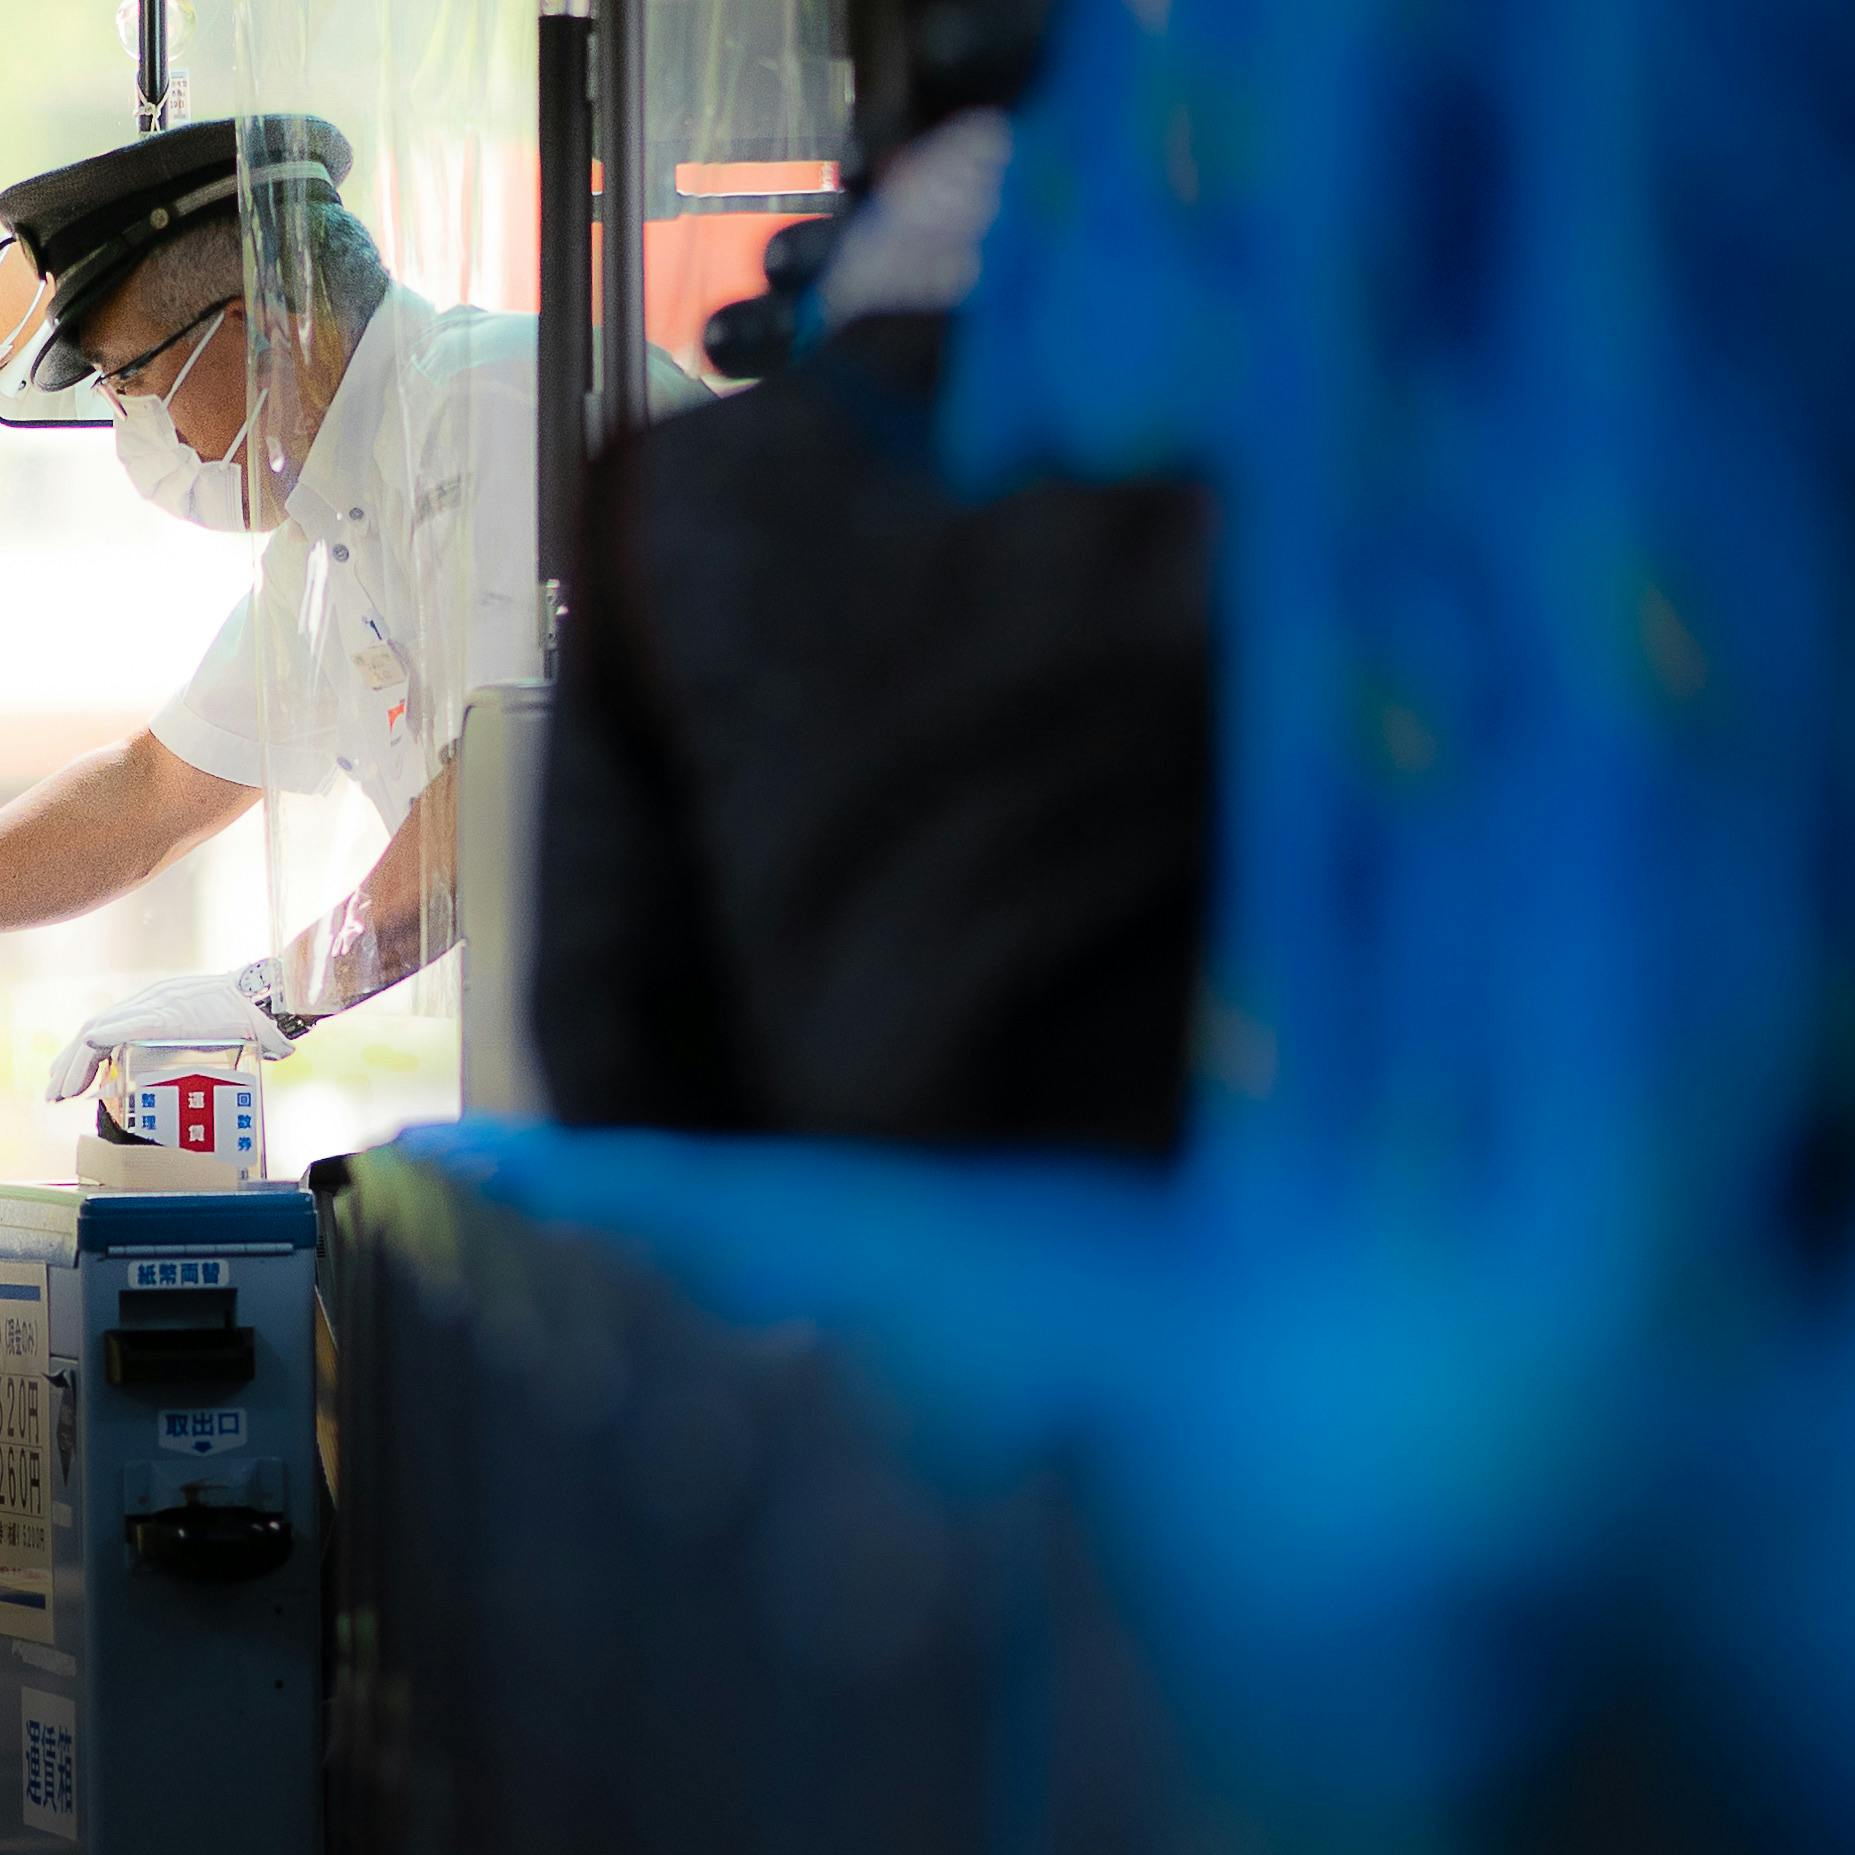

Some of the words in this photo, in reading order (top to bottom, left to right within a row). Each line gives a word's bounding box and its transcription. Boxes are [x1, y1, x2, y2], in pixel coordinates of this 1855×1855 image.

[141, 1092, 156, 1145] 整理
[137, 1262, 220, 1285] 紙幣両替
[165, 1412, 240, 1437] 取出口
